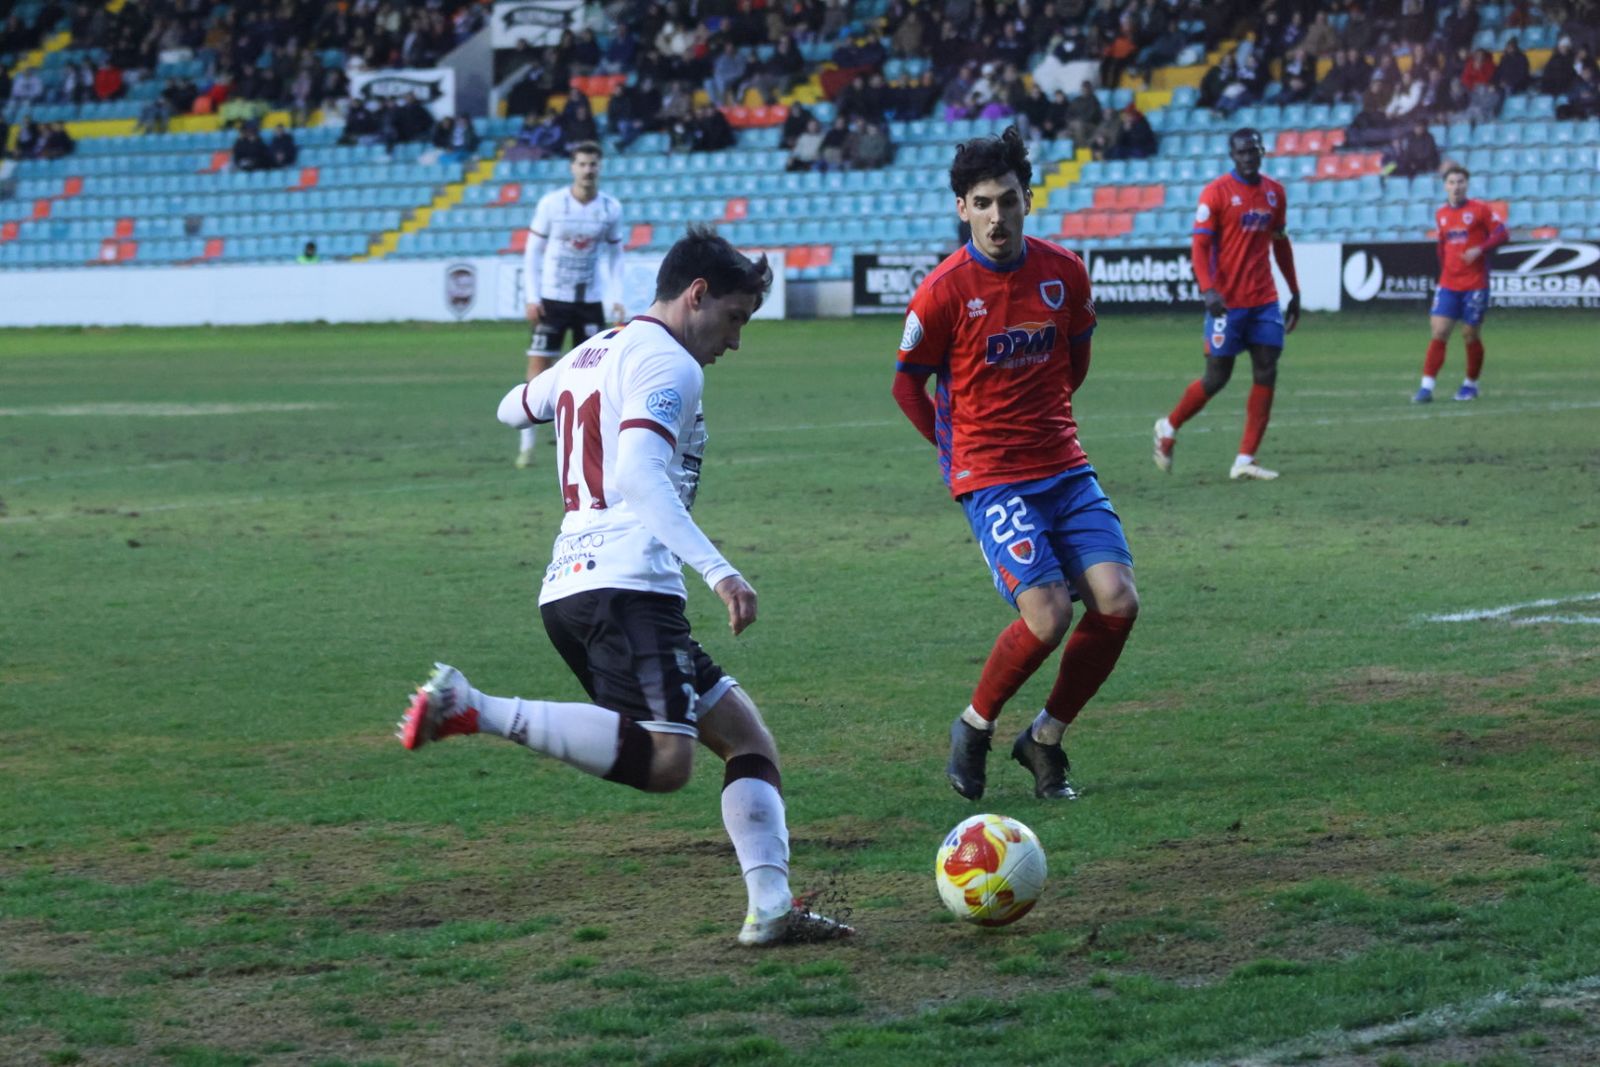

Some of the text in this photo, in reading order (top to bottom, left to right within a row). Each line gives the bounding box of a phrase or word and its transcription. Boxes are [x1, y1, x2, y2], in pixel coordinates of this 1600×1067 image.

[1091, 256, 1194, 282] Autolack
[985, 322, 1057, 366] DPM
[556, 389, 609, 513] 21
[985, 496, 1035, 544] 22
